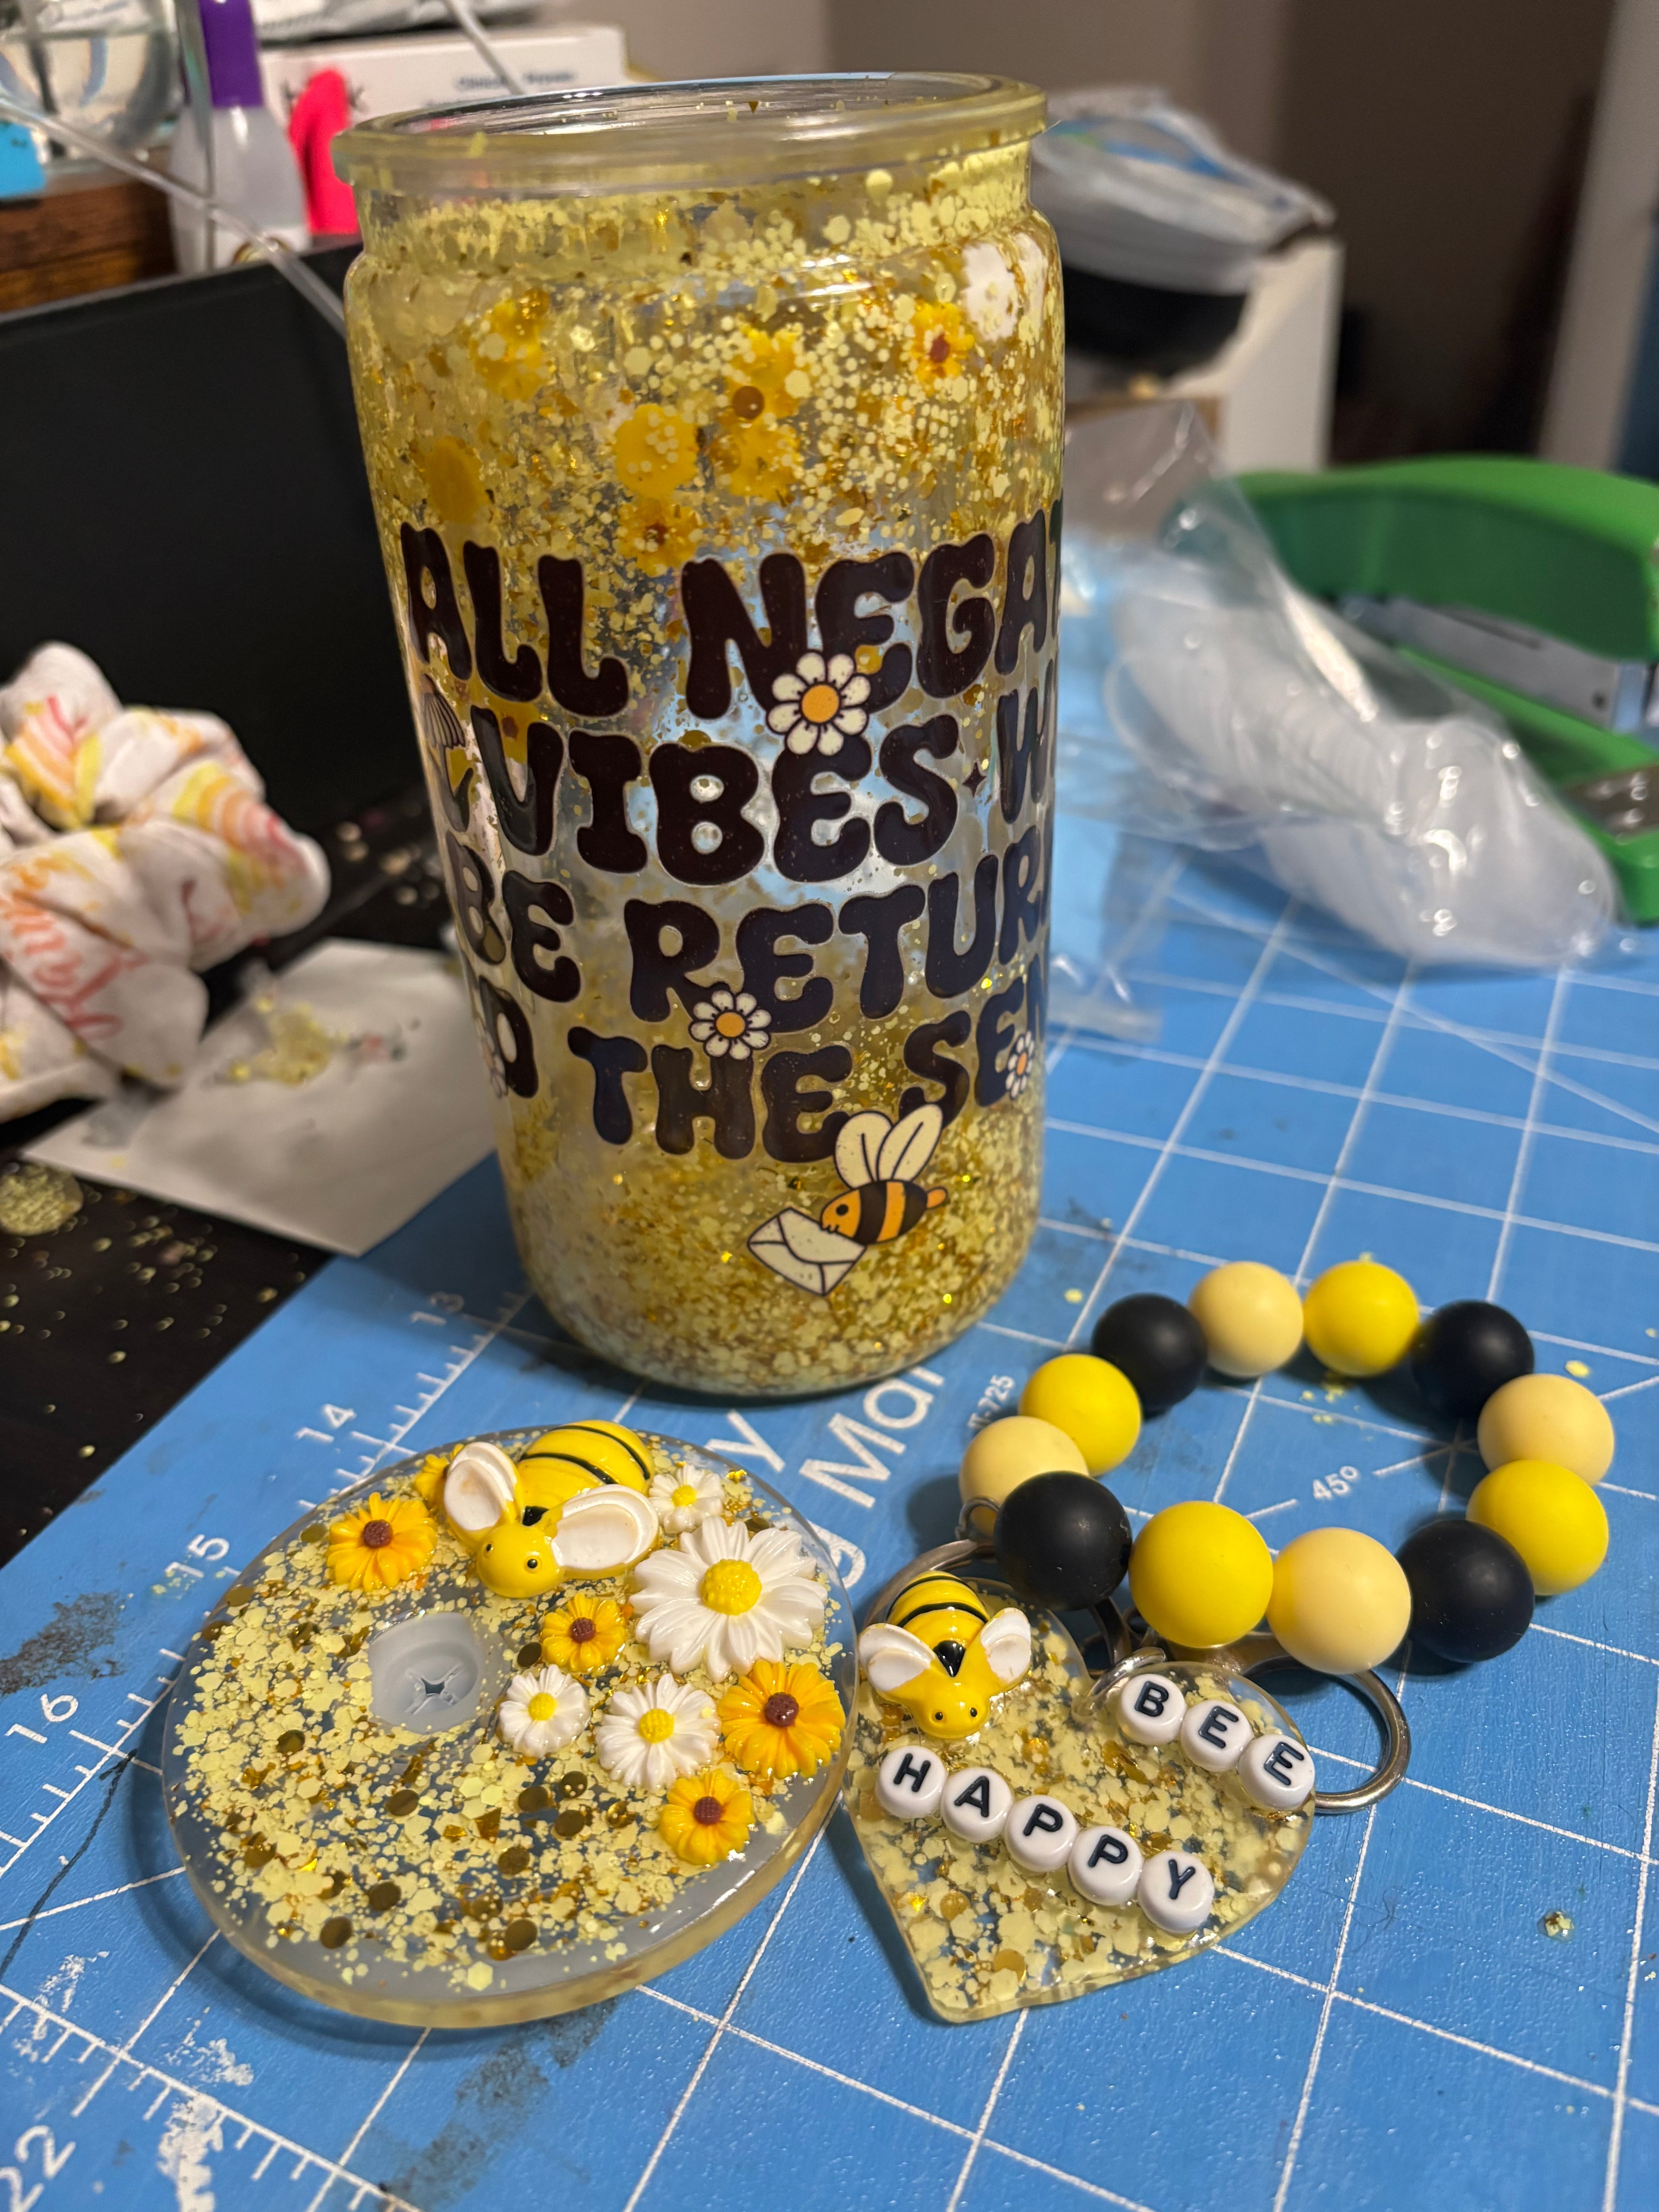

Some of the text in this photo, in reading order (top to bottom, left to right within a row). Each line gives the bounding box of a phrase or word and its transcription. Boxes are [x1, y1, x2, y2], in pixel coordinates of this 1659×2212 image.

[400, 521, 629, 717] ALL
[470, 705, 959, 885] VIBES
[445, 832, 581, 1002] BE
[567, 1026, 853, 1163] THE
[410, 1291, 465, 1326] 13
[295, 1403, 357, 1444] 14
[164, 1534, 230, 1579] 15
[4, 1694, 79, 1744] 16
[1133, 1679, 1306, 1787] BEE
[892, 1752, 1198, 1901] HAPPY
[0, 2125, 76, 2212] 22
